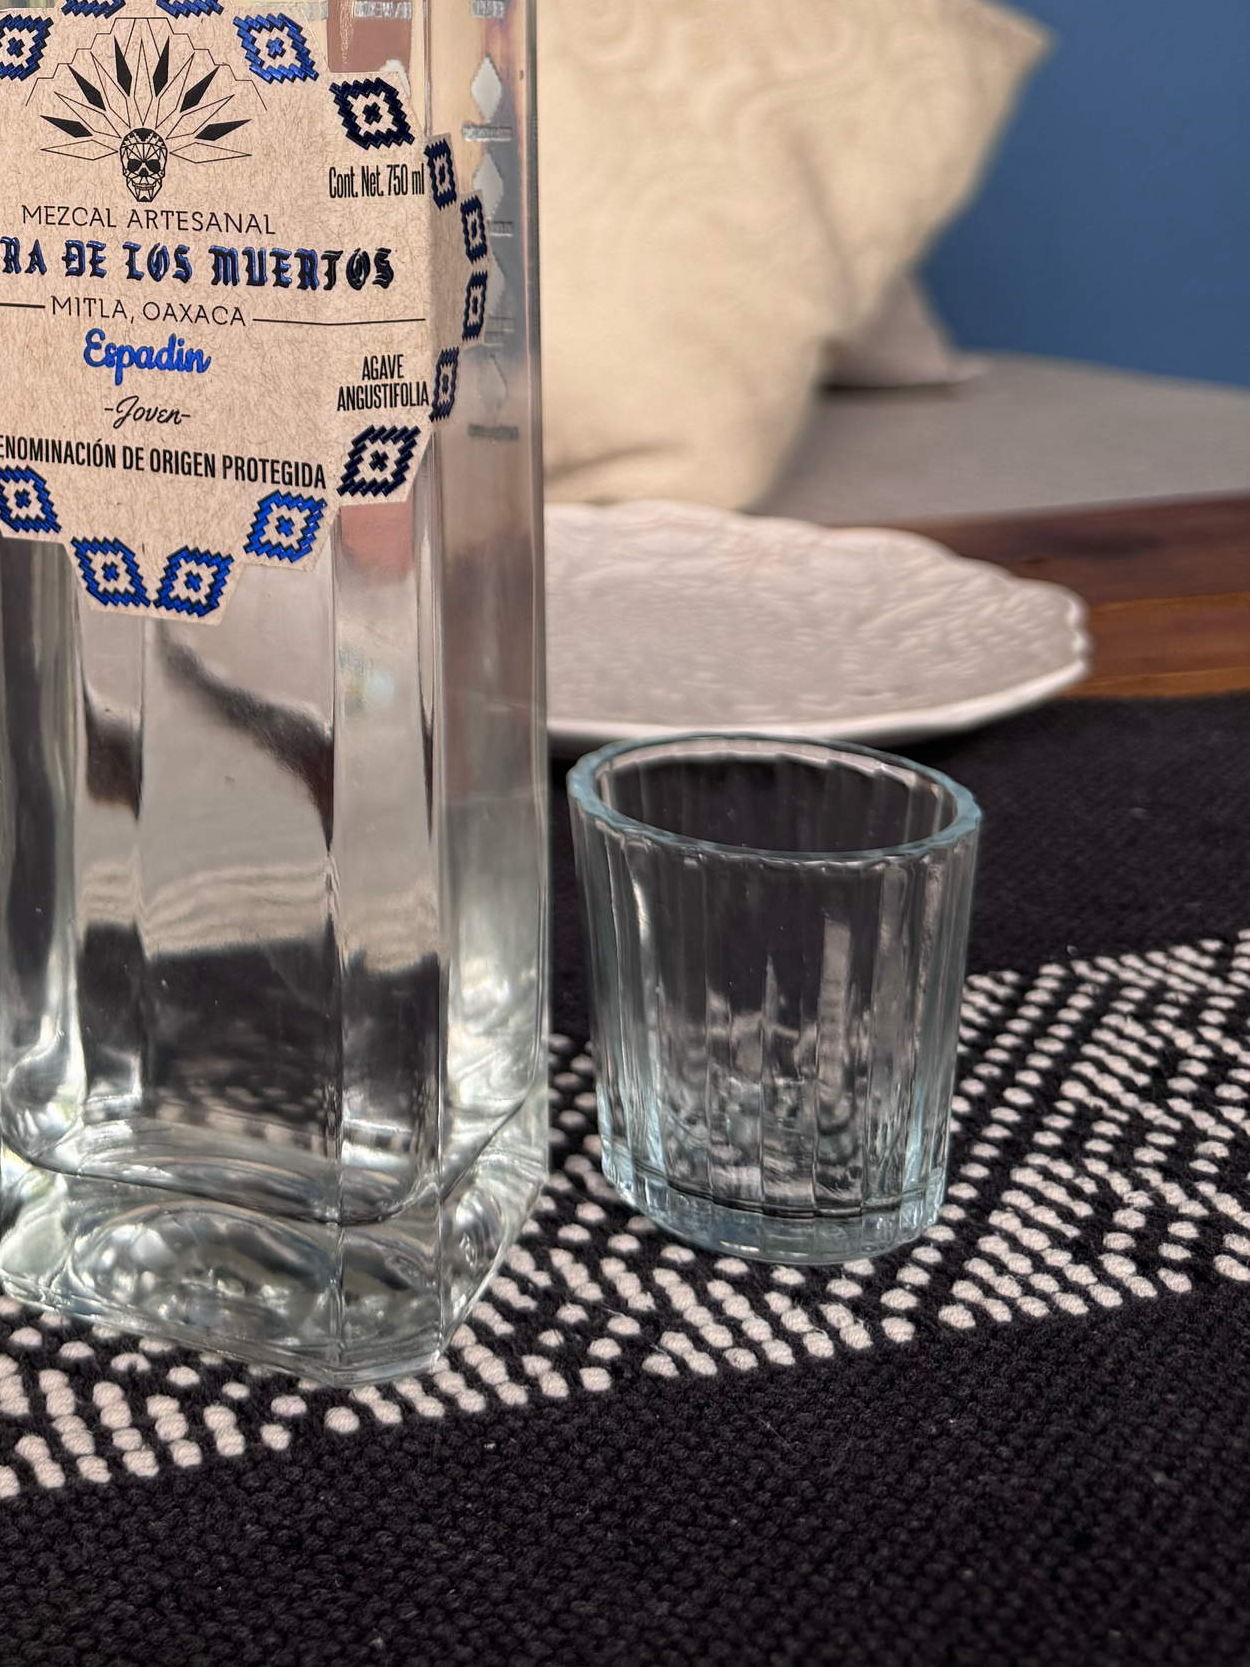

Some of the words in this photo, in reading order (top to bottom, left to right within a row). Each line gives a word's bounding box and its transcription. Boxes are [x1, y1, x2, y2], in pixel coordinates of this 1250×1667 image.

[329, 166, 359, 199] Cont.
[361, 165, 384, 197] Net.
[386, 163, 408, 196] 750
[412, 162, 425, 195] ml
[21, 205, 117, 228] MEZCAL
[127, 209, 276, 235] ARTESANAL
[61, 239, 107, 279] DE
[122, 241, 193, 284] LOS
[208, 245, 394, 291] MUERTOS
[51, 295, 135, 324] MITLA,
[143, 301, 246, 327] OAXACA
[83, 328, 211, 386] Espadin
[362, 354, 405, 381] AGAVE
[337, 381, 429, 412] ANGUSTIFOLIA
[122, 444, 145, 472] DE
[150, 447, 216, 478] ORIGEN
[222, 454, 327, 490] PROTEGIDA
